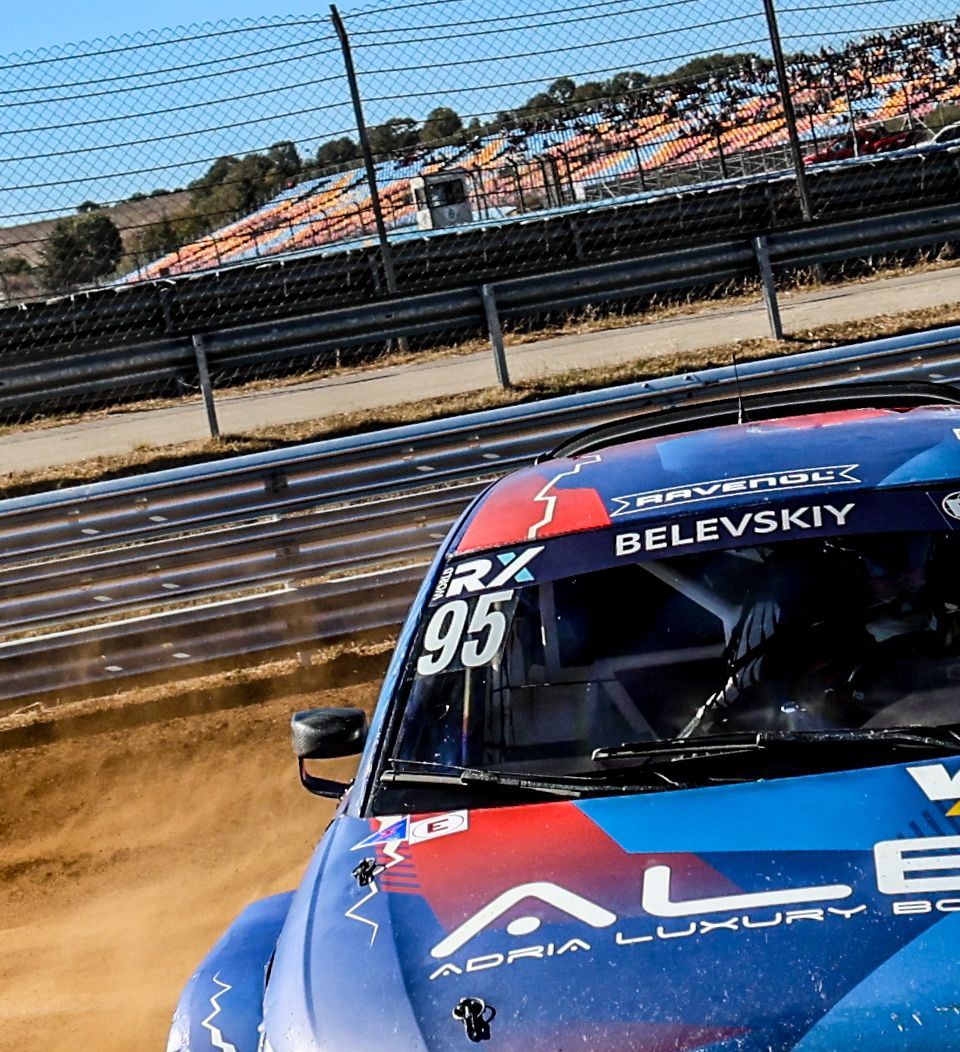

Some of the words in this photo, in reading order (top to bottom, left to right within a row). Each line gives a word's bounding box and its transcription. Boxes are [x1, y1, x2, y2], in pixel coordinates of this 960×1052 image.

[635, 471, 835, 508] RAVENOL
[615, 503, 856, 556] BELEVSKIY
[432, 567, 454, 601] WORLD
[445, 546, 545, 597] RX
[417, 589, 514, 675] 95
[427, 818, 449, 834] E
[429, 938, 591, 980] ADRIA
[616, 904, 867, 945] LUXURY
